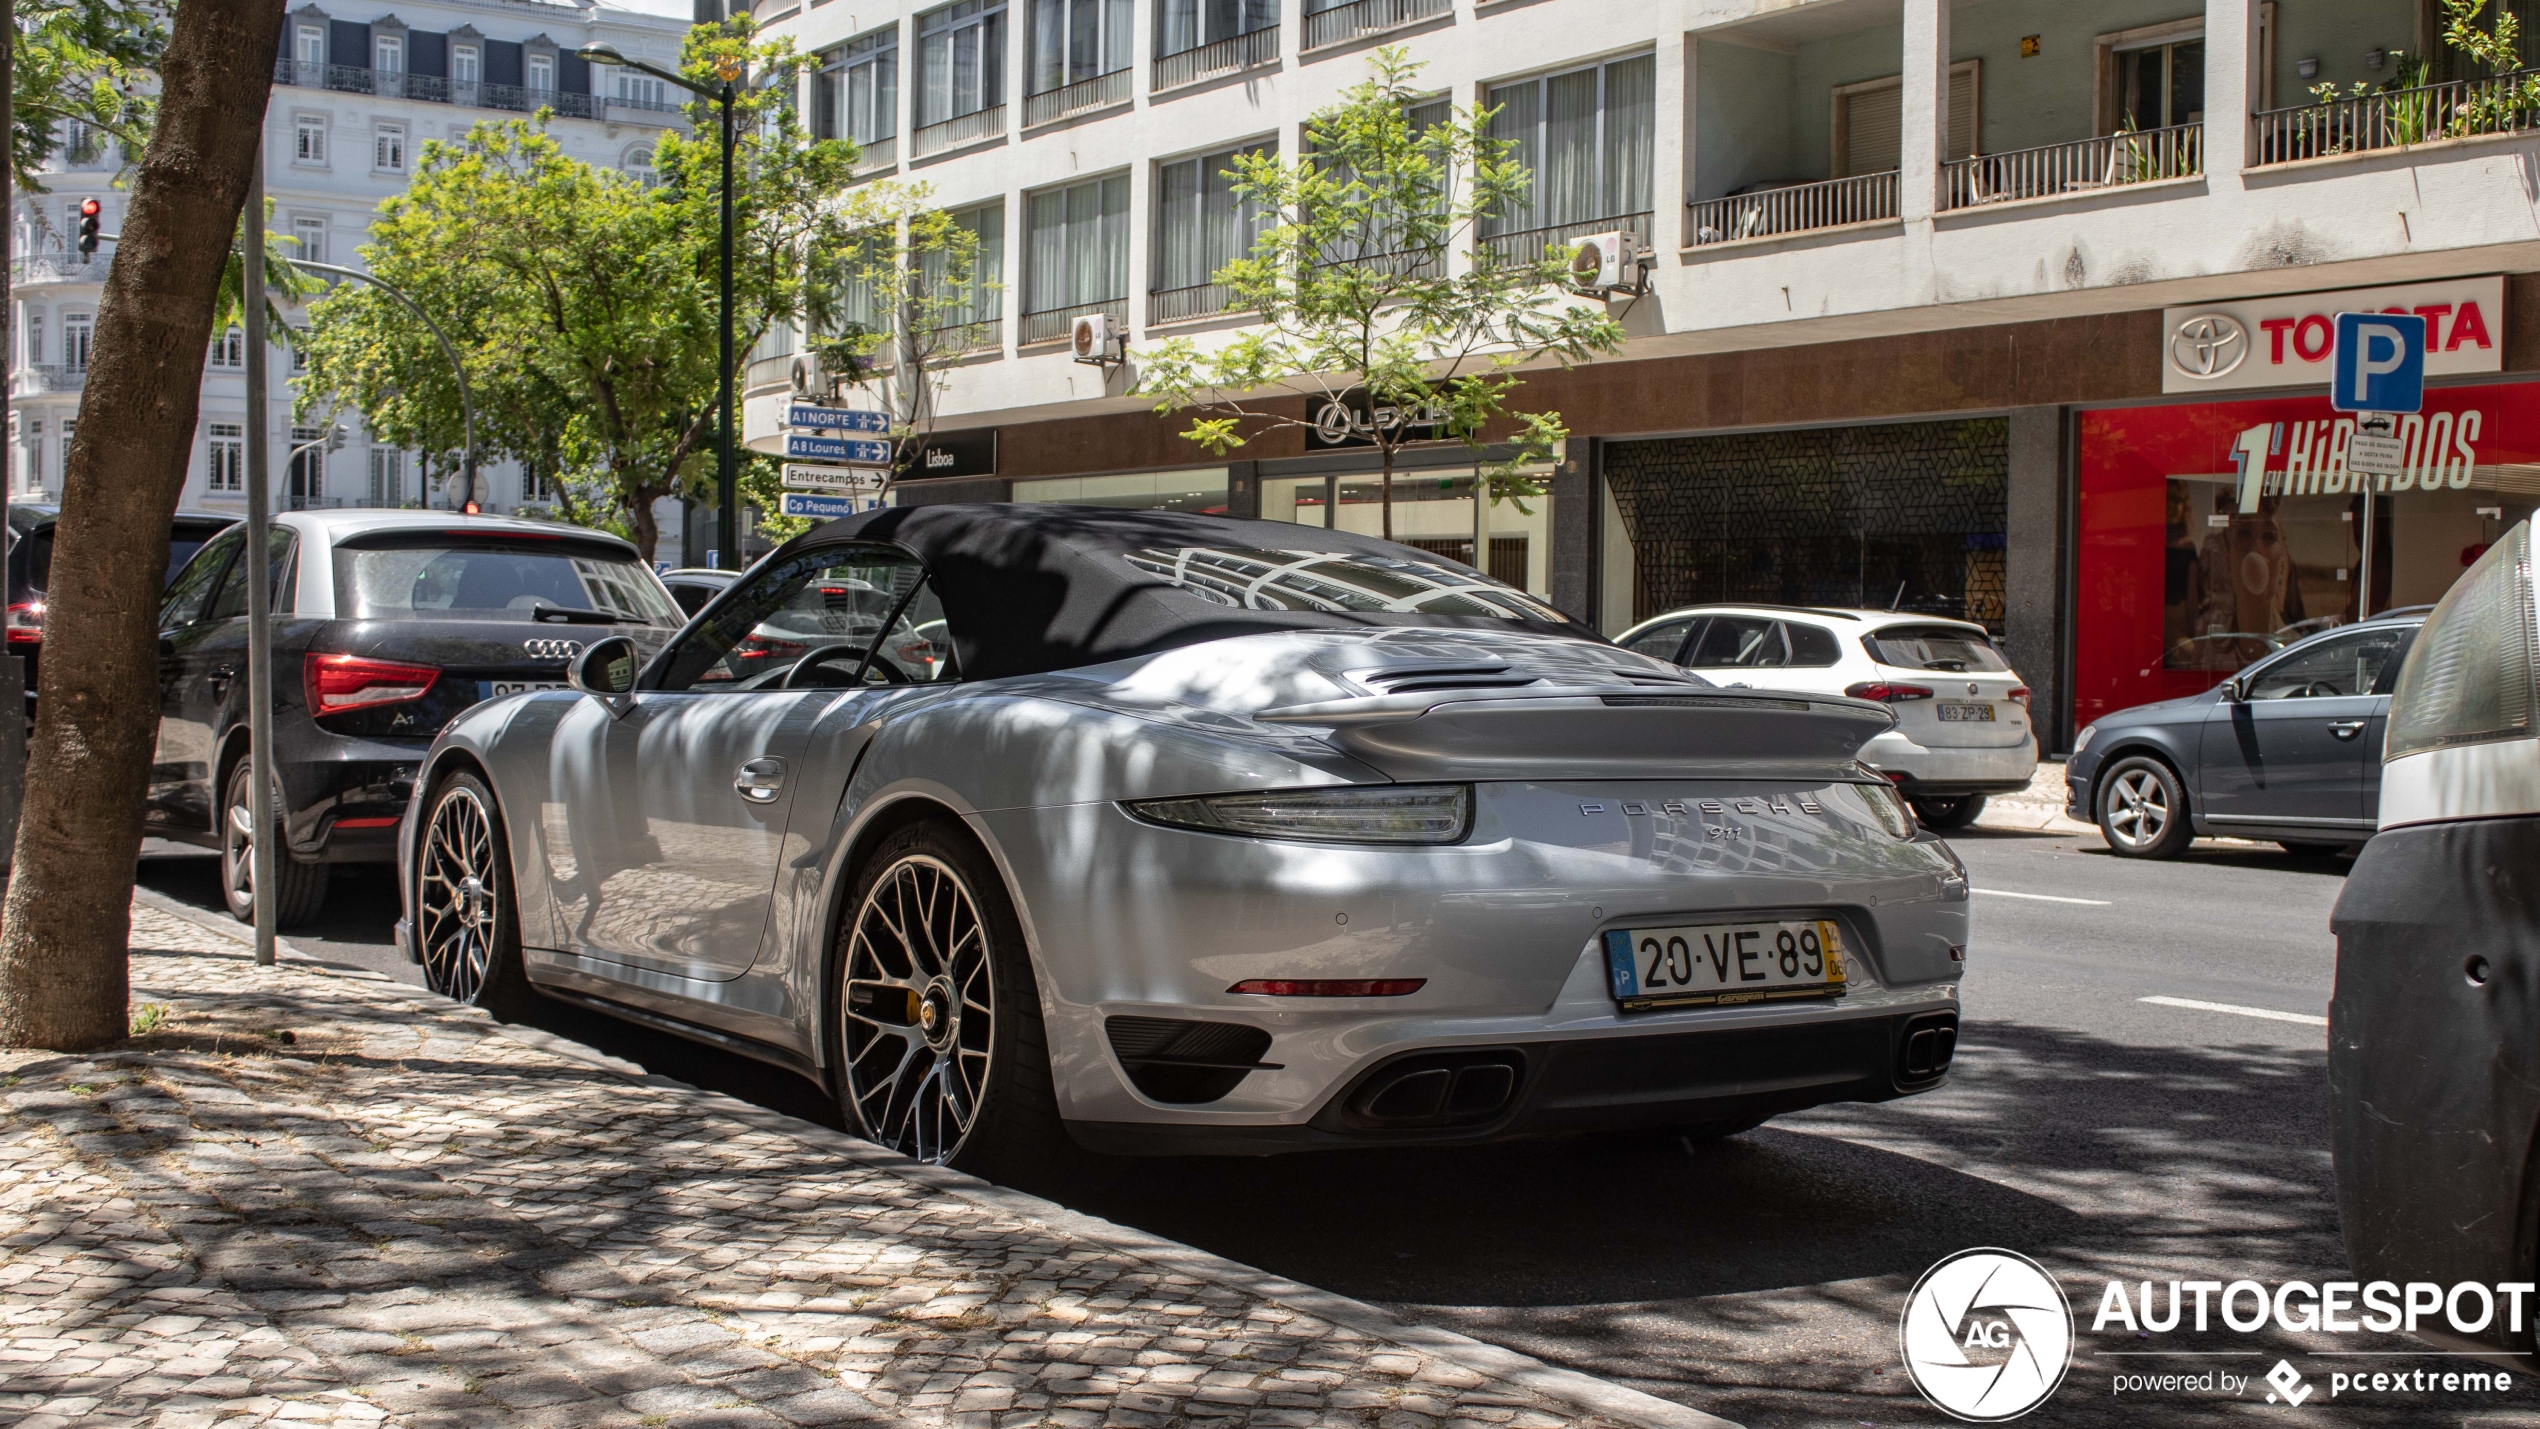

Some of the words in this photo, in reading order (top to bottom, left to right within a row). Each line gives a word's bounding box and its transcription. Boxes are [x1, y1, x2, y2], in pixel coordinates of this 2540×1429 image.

[1606, 255, 1616, 263] LG
[2260, 301, 2492, 365] TOTA
[2354, 323, 2406, 402] P
[808, 412, 850, 425] NORTE
[810, 441, 846, 454] Loures
[926, 448, 954, 468] Lisboa
[790, 469, 866, 486] Entrecampos
[789, 498, 803, 512] Cp
[806, 500, 850, 514] Pequeno
[392, 712, 414, 726] A1
[1579, 801, 1822, 816] PORSCHE
[1708, 826, 1742, 841] 911
[1620, 970, 1630, 985] P
